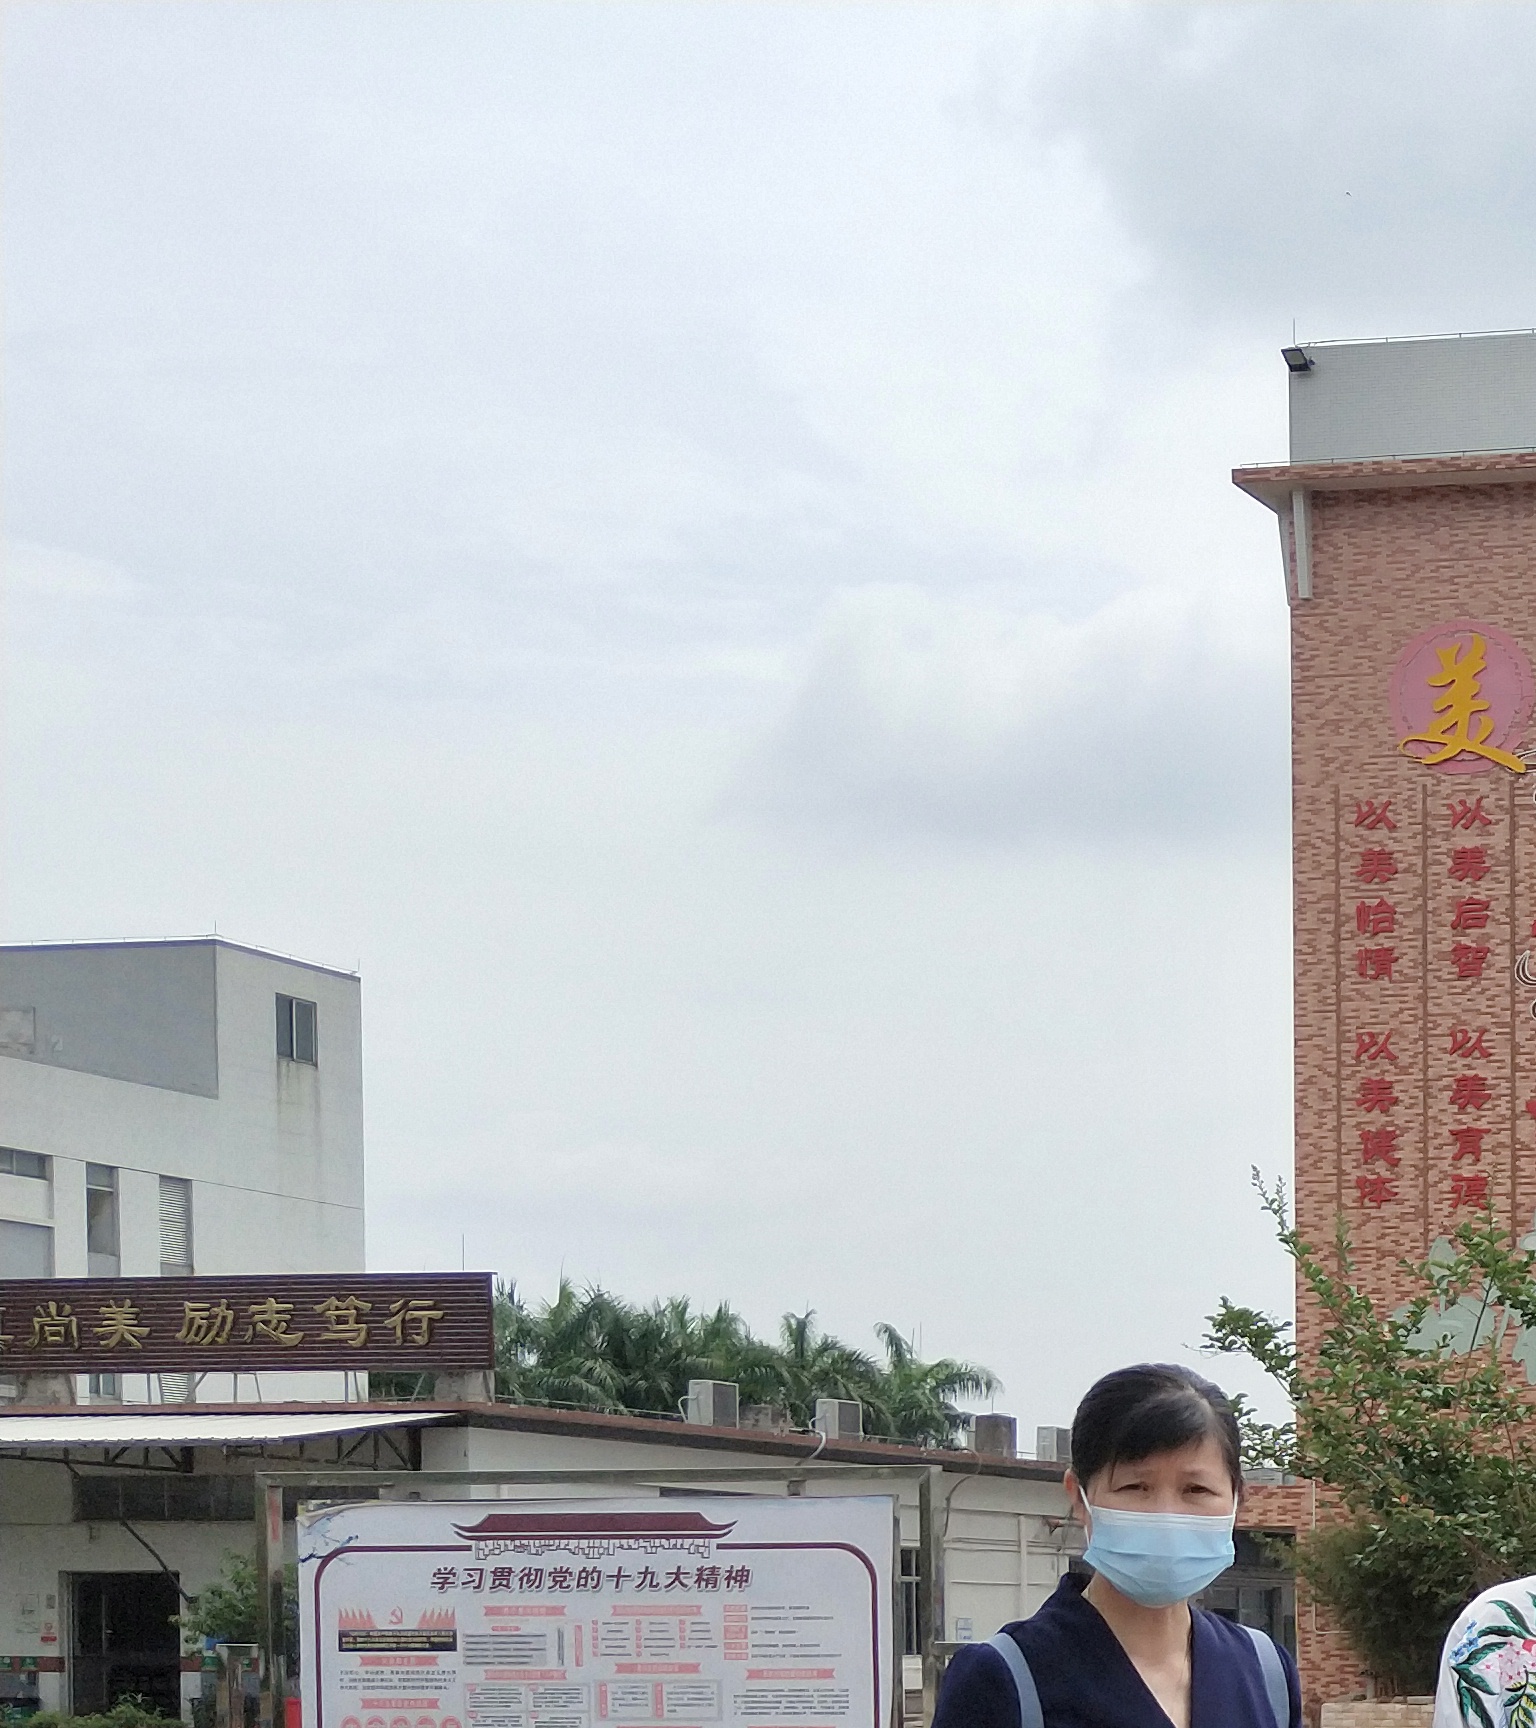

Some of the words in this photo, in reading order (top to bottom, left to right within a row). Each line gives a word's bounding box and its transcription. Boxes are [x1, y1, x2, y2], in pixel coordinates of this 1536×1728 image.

[1401, 634, 1526, 773] 美
[1447, 797, 1492, 978] 以美启智
[0, 1294, 445, 1352] 尚美励志笃行
[430, 1565, 752, 1593] 学习贯彻党的十九大精神
